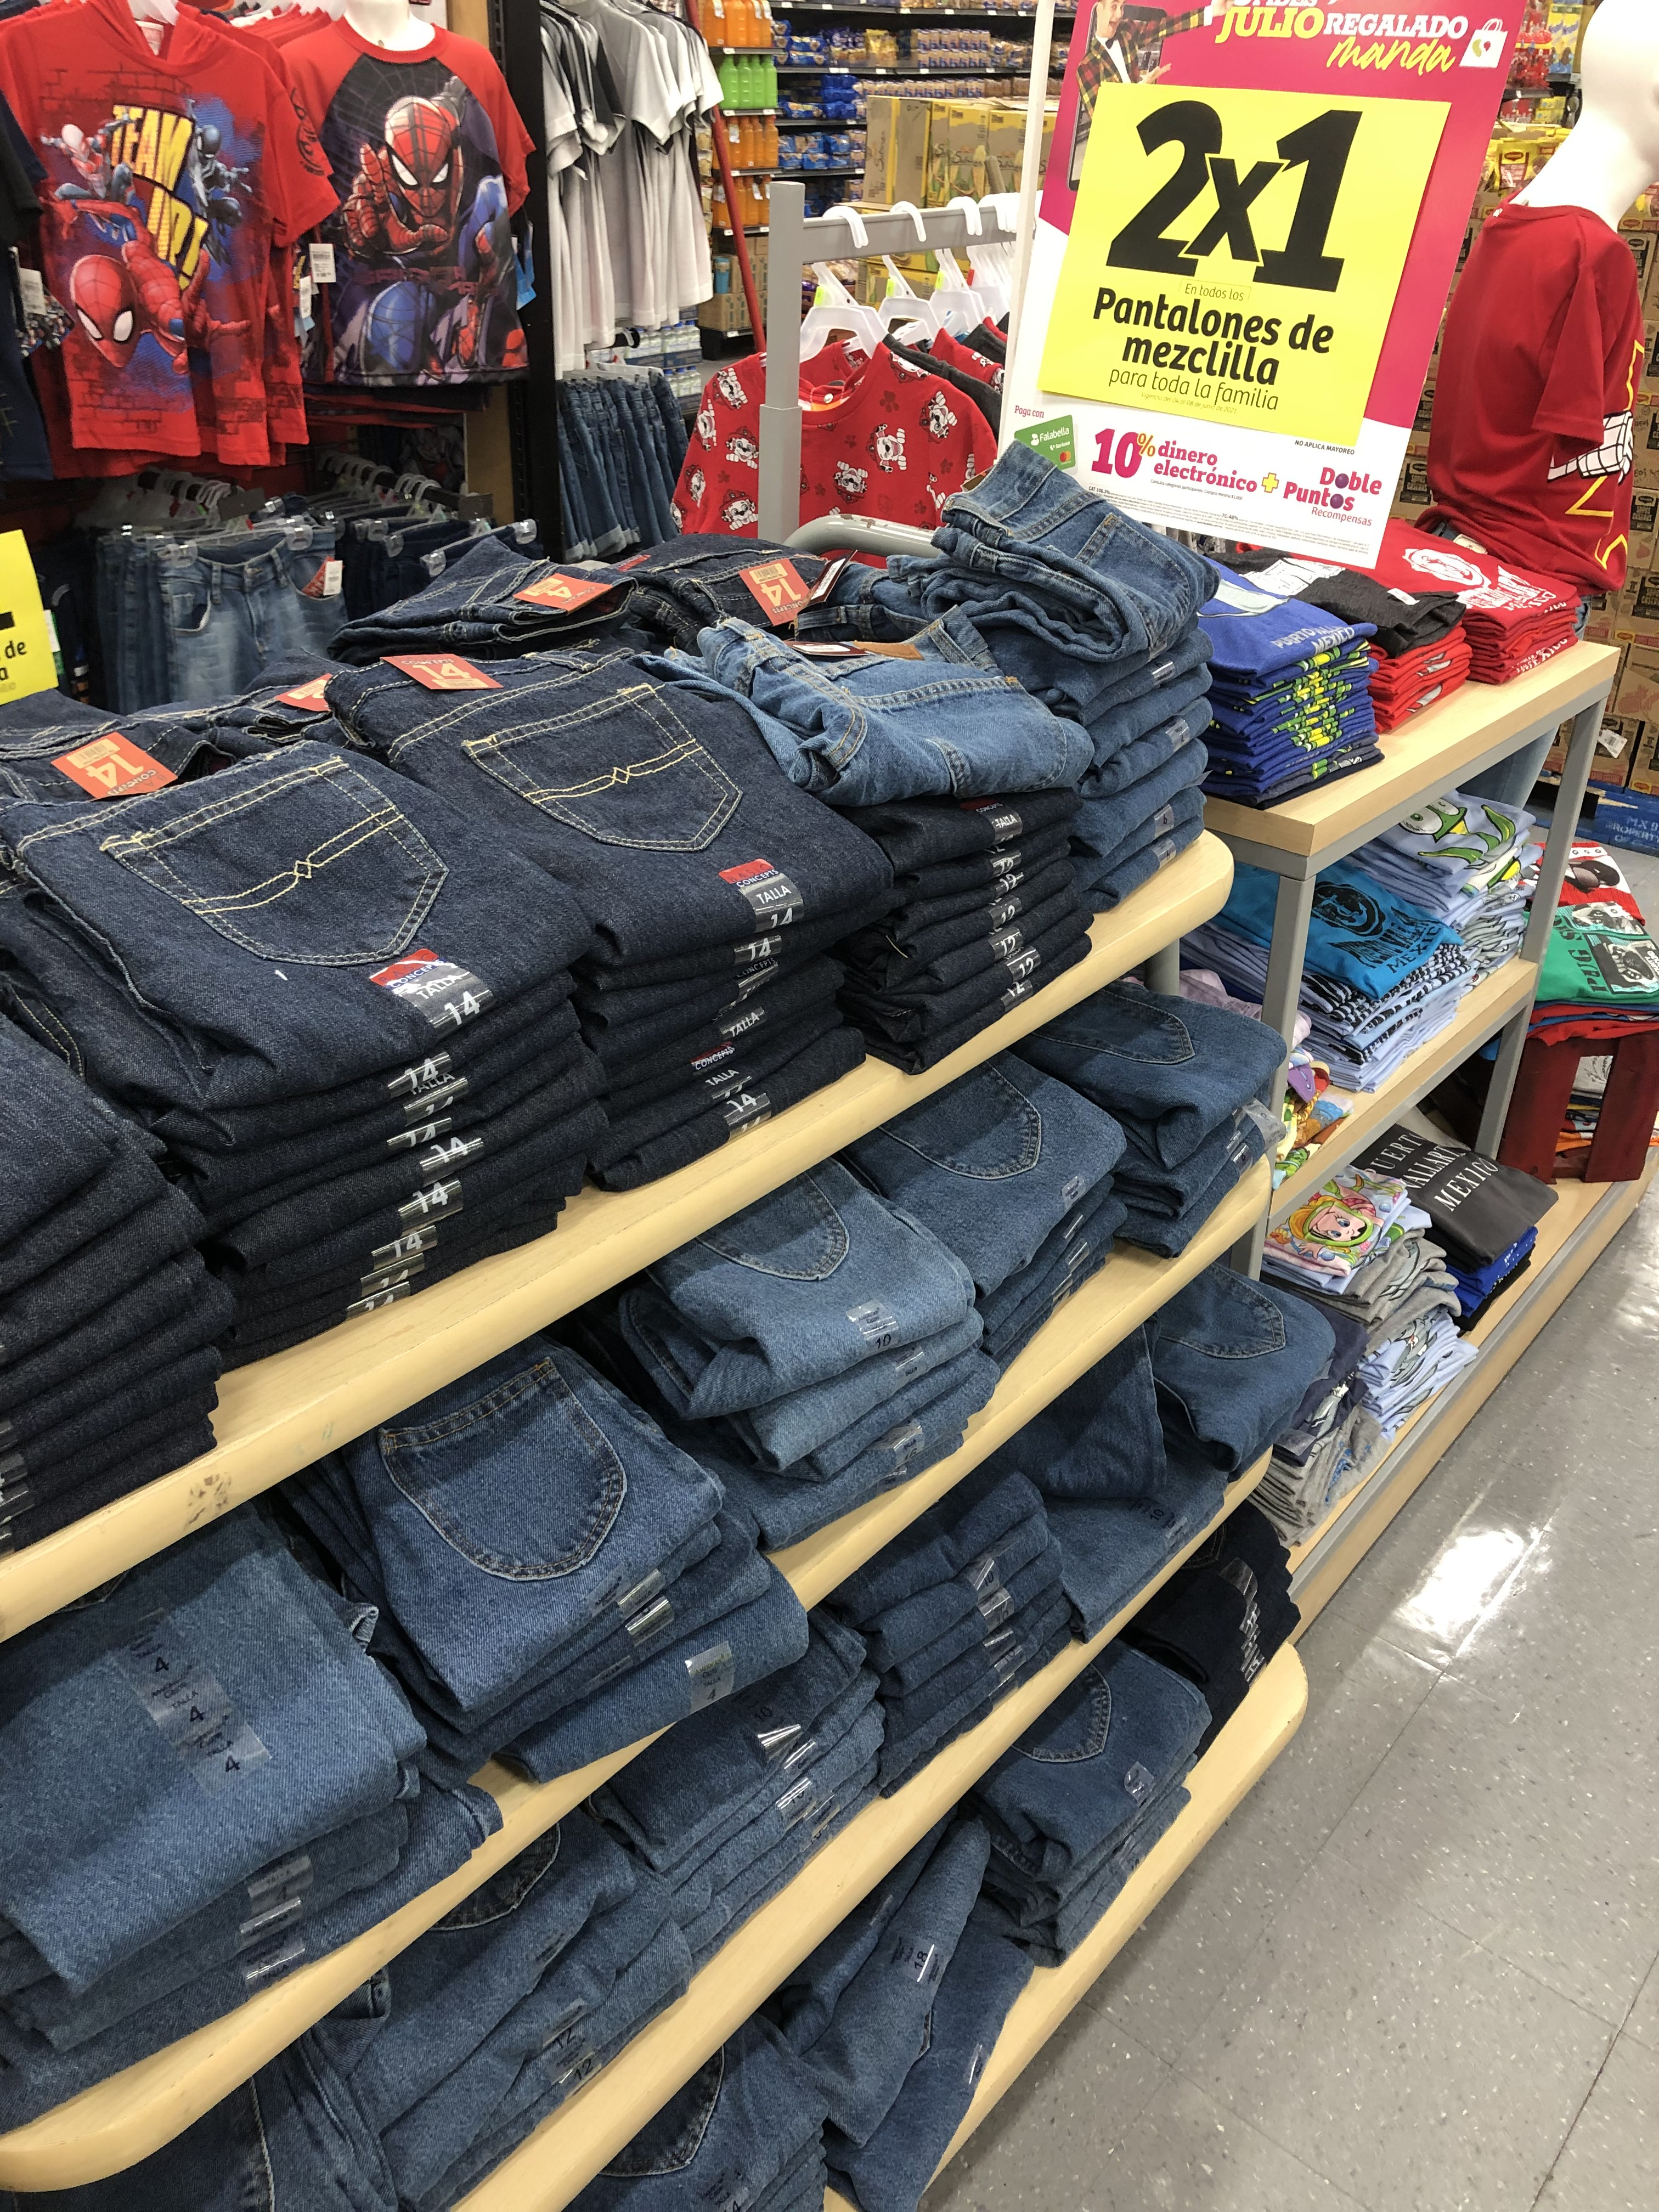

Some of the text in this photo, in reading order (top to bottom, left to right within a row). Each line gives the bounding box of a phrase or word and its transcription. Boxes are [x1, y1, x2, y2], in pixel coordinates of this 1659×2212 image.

[1215, 7, 1469, 43] JULIO REGALADO
[1327, 36, 1456, 76] manda
[1105, 100, 1363, 292] 2x1
[1185, 283, 1244, 301] En todos los
[1093, 287, 1334, 353] Pantalones de
[1122, 336, 1279, 385] mezclilla
[1109, 369, 1279, 410] para toda la familia
[1014, 405, 1045, 418] Paga con
[1040, 427, 1069, 442] Falabella
[1158, 440, 1217, 466] dinero
[1305, 441, 1325, 450] APLICA
[1326, 445, 1355, 455] MAYOREO
[1154, 460, 1257, 492] electrónico
[1319, 467, 1382, 495] Doble
[1283, 481, 1355, 511] Puntos
[1312, 506, 1372, 526] Recompensas
[760, 578, 802, 607] 14
[772, 600, 803, 614] ONCEPTS
[413, 663, 472, 680] 14
[85, 753, 144, 789] 14
[736, 869, 780, 888] CONCEPTS
[756, 885, 792, 905] TALLA
[748, 938, 771, 961] 14
[1386, 926, 1442, 974] MEXIC
[444, 991, 481, 1026] 14
[729, 1012, 760, 1037] TALLA
[405, 1058, 439, 1089] 14
[705, 1069, 740, 1086] TALLA
[726, 1093, 758, 1113] 14
[413, 1182, 448, 1213] 14
[1434, 1157, 1498, 1212] MEXICO
[394, 1231, 423, 1258] 14
[876, 1334, 892, 1349] 10
[155, 1656, 170, 1672] 4
[190, 1706, 206, 1722] 4
[225, 1755, 240, 1773] 4
